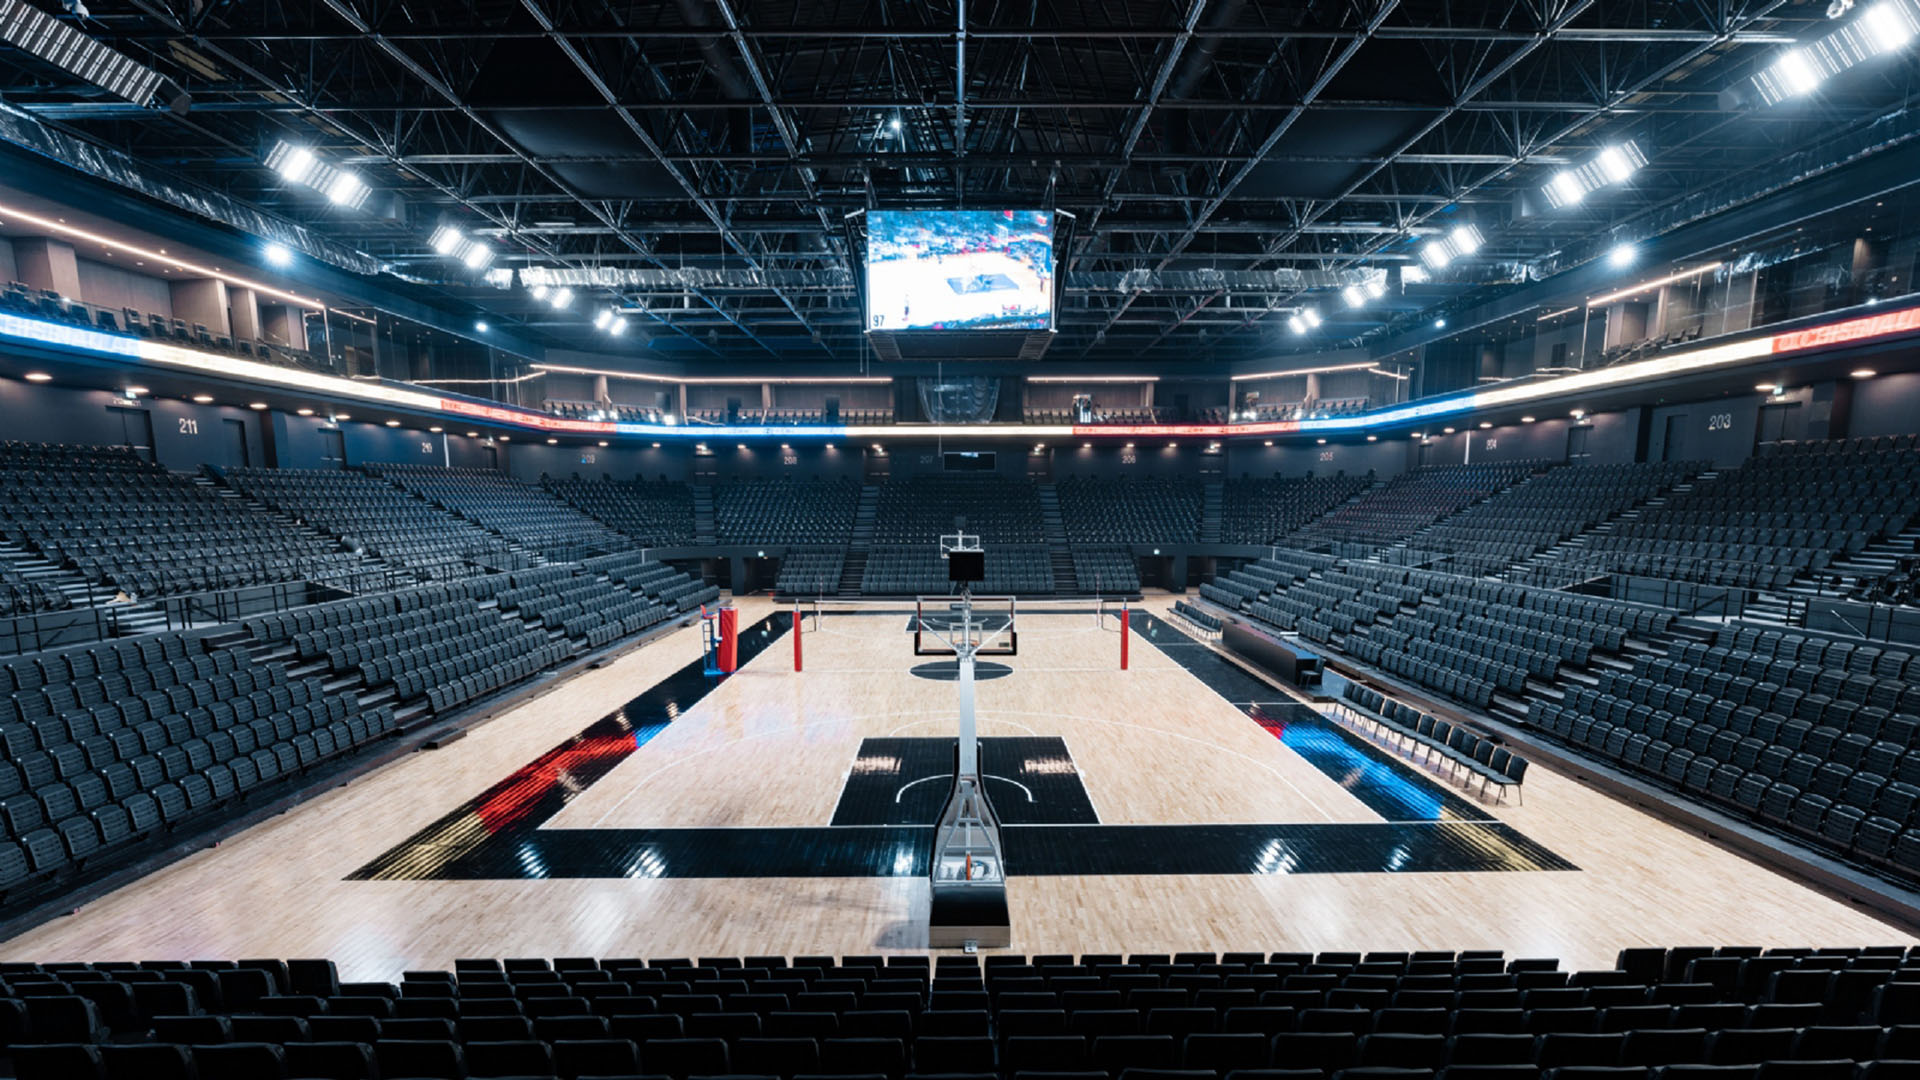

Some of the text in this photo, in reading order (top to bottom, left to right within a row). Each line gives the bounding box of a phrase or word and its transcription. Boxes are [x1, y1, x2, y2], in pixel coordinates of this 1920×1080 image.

[873, 314, 885, 327] 97
[178, 417, 198, 435] 211
[1708, 413, 1731, 430] 203
